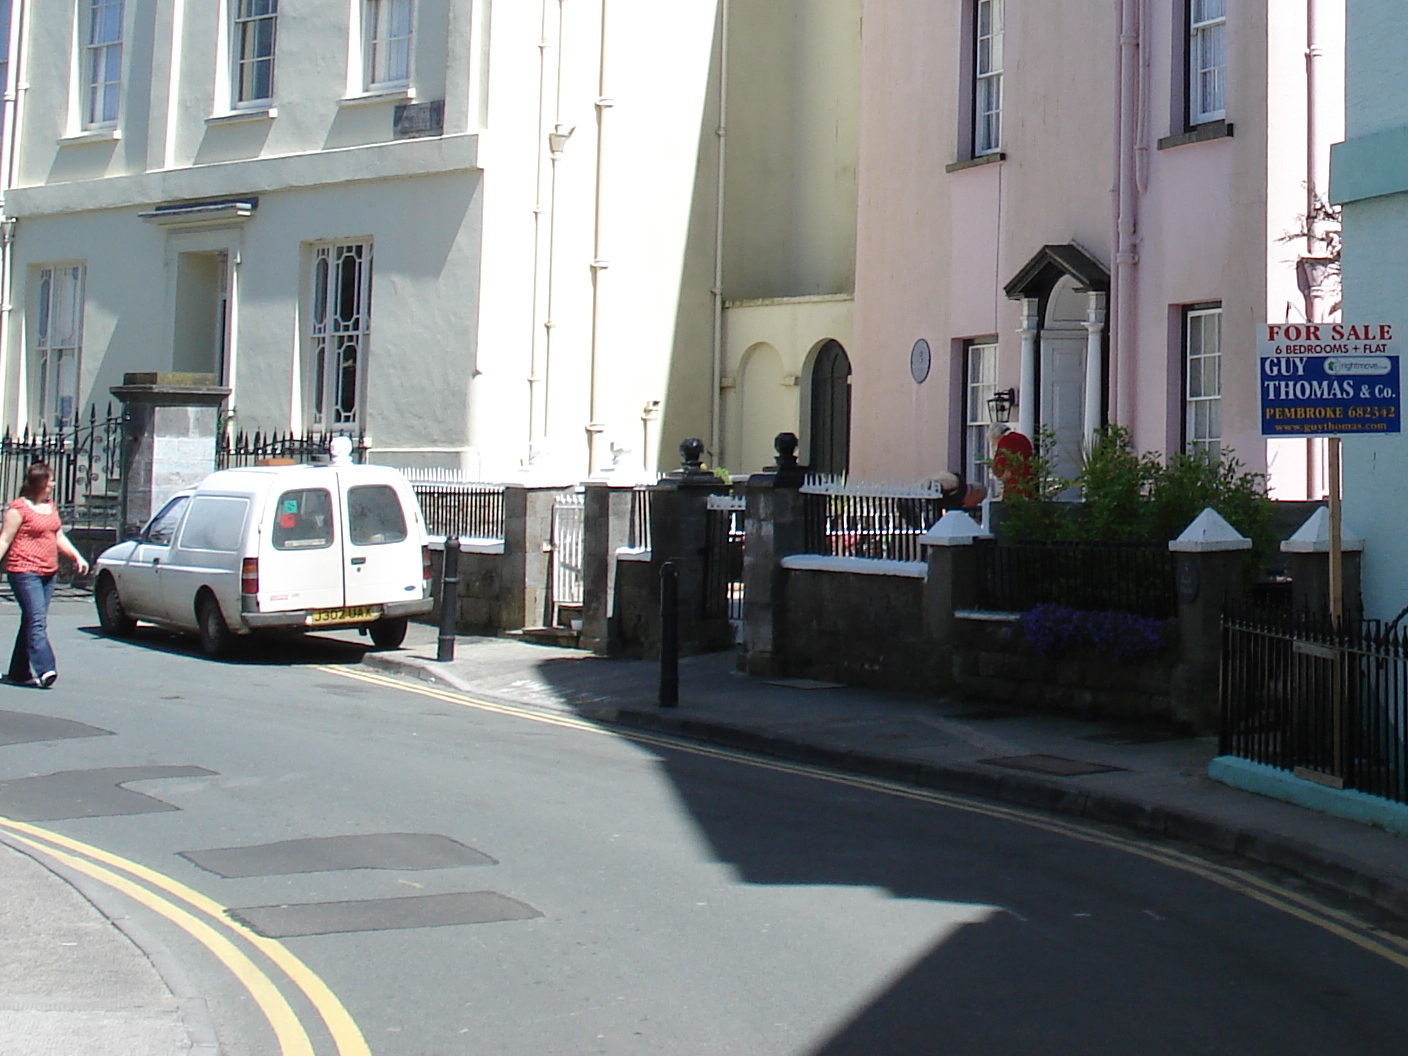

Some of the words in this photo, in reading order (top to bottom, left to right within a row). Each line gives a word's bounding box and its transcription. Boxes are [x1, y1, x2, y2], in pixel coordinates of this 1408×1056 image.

[1267, 325, 1322, 341] FOR
[1331, 324, 1393, 341] SALE
[1275, 345, 1282, 355] 6
[1285, 344, 1349, 355] BEDROOMS
[1352, 345, 1360, 353] +
[1363, 344, 1388, 354] FLAT
[1264, 357, 1307, 376] GUY
[1264, 380, 1354, 399] THOMAS
[1359, 384, 1371, 398] &
[1266, 407, 1343, 419] PEMBROKE
[1274, 422, 1387, 433] www.guythomas.com
[315, 609, 346, 622] J302
